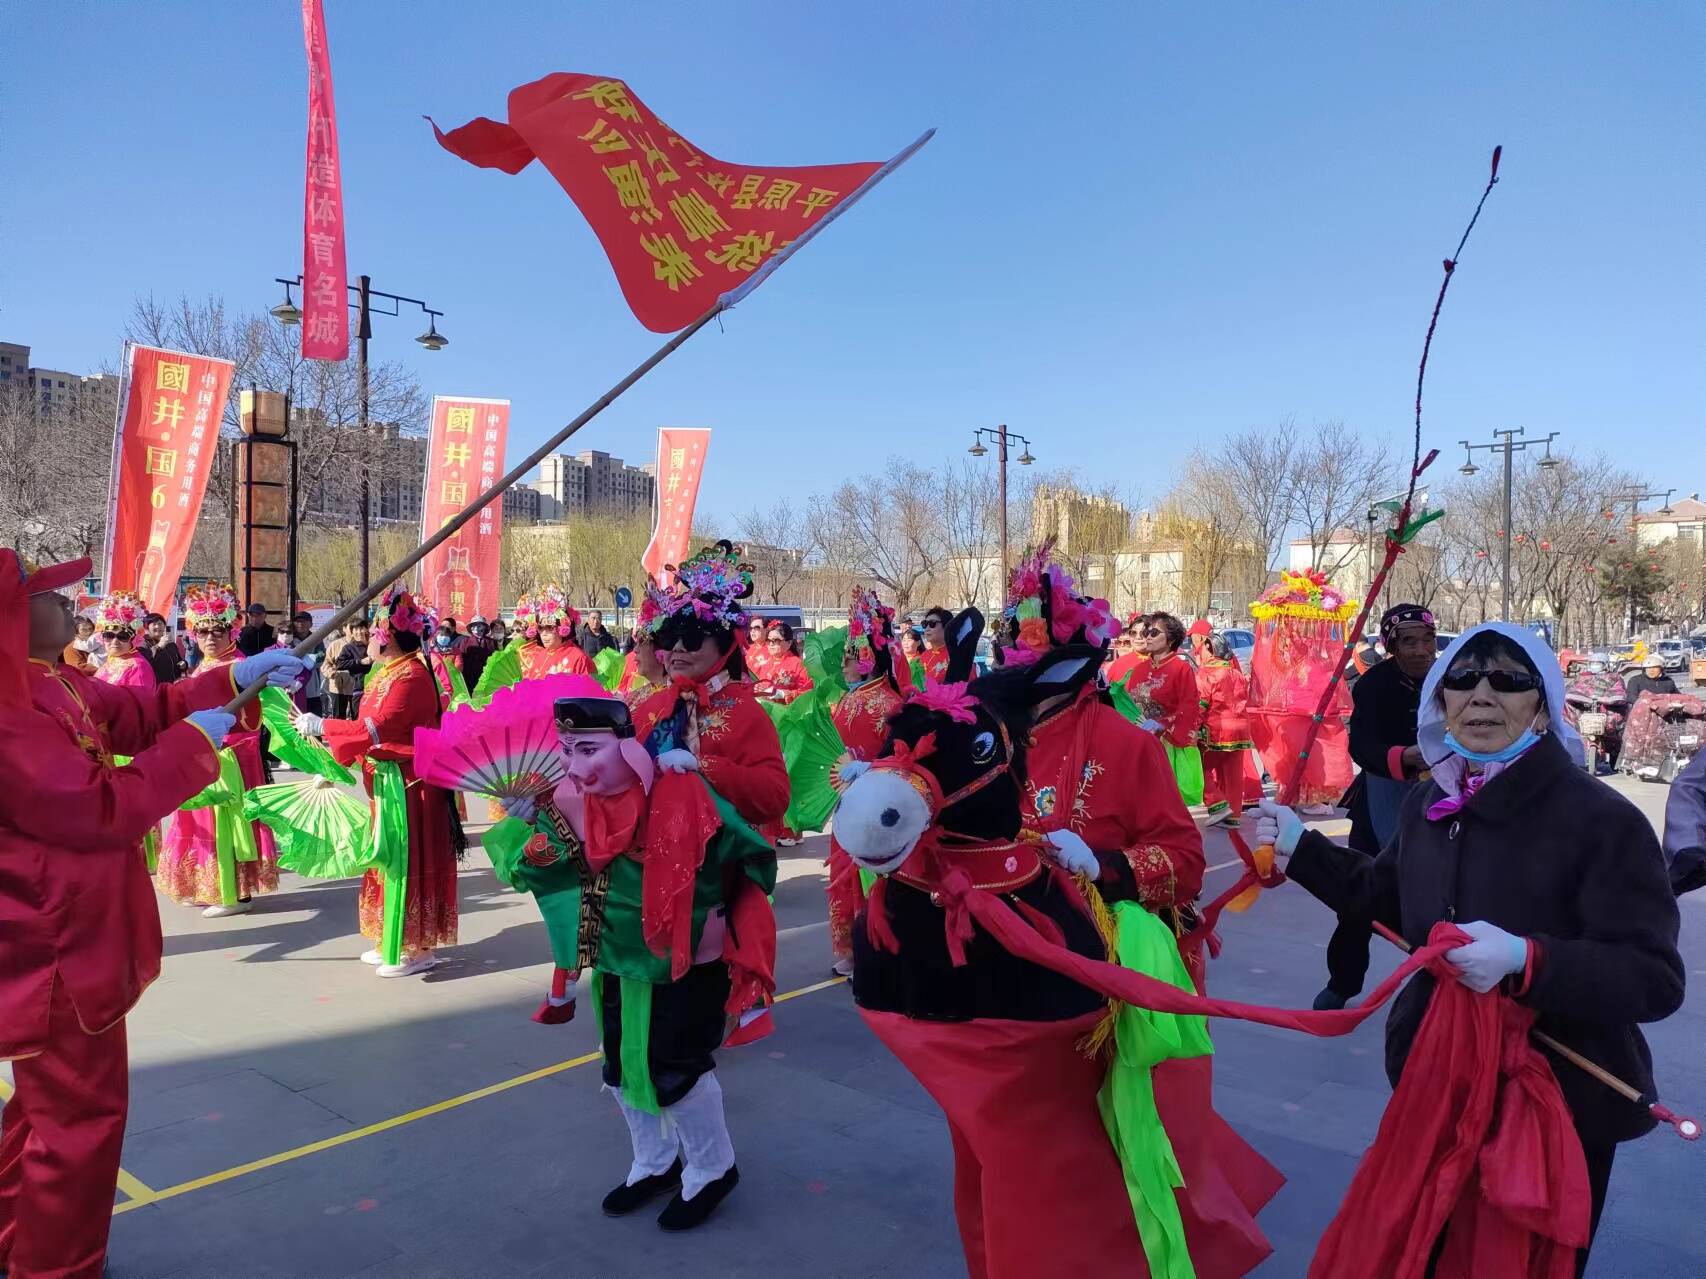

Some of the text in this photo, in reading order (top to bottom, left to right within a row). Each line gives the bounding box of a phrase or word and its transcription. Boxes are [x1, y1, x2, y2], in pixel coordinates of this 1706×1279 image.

[478, 413, 500, 536] 中国高端商用酒
